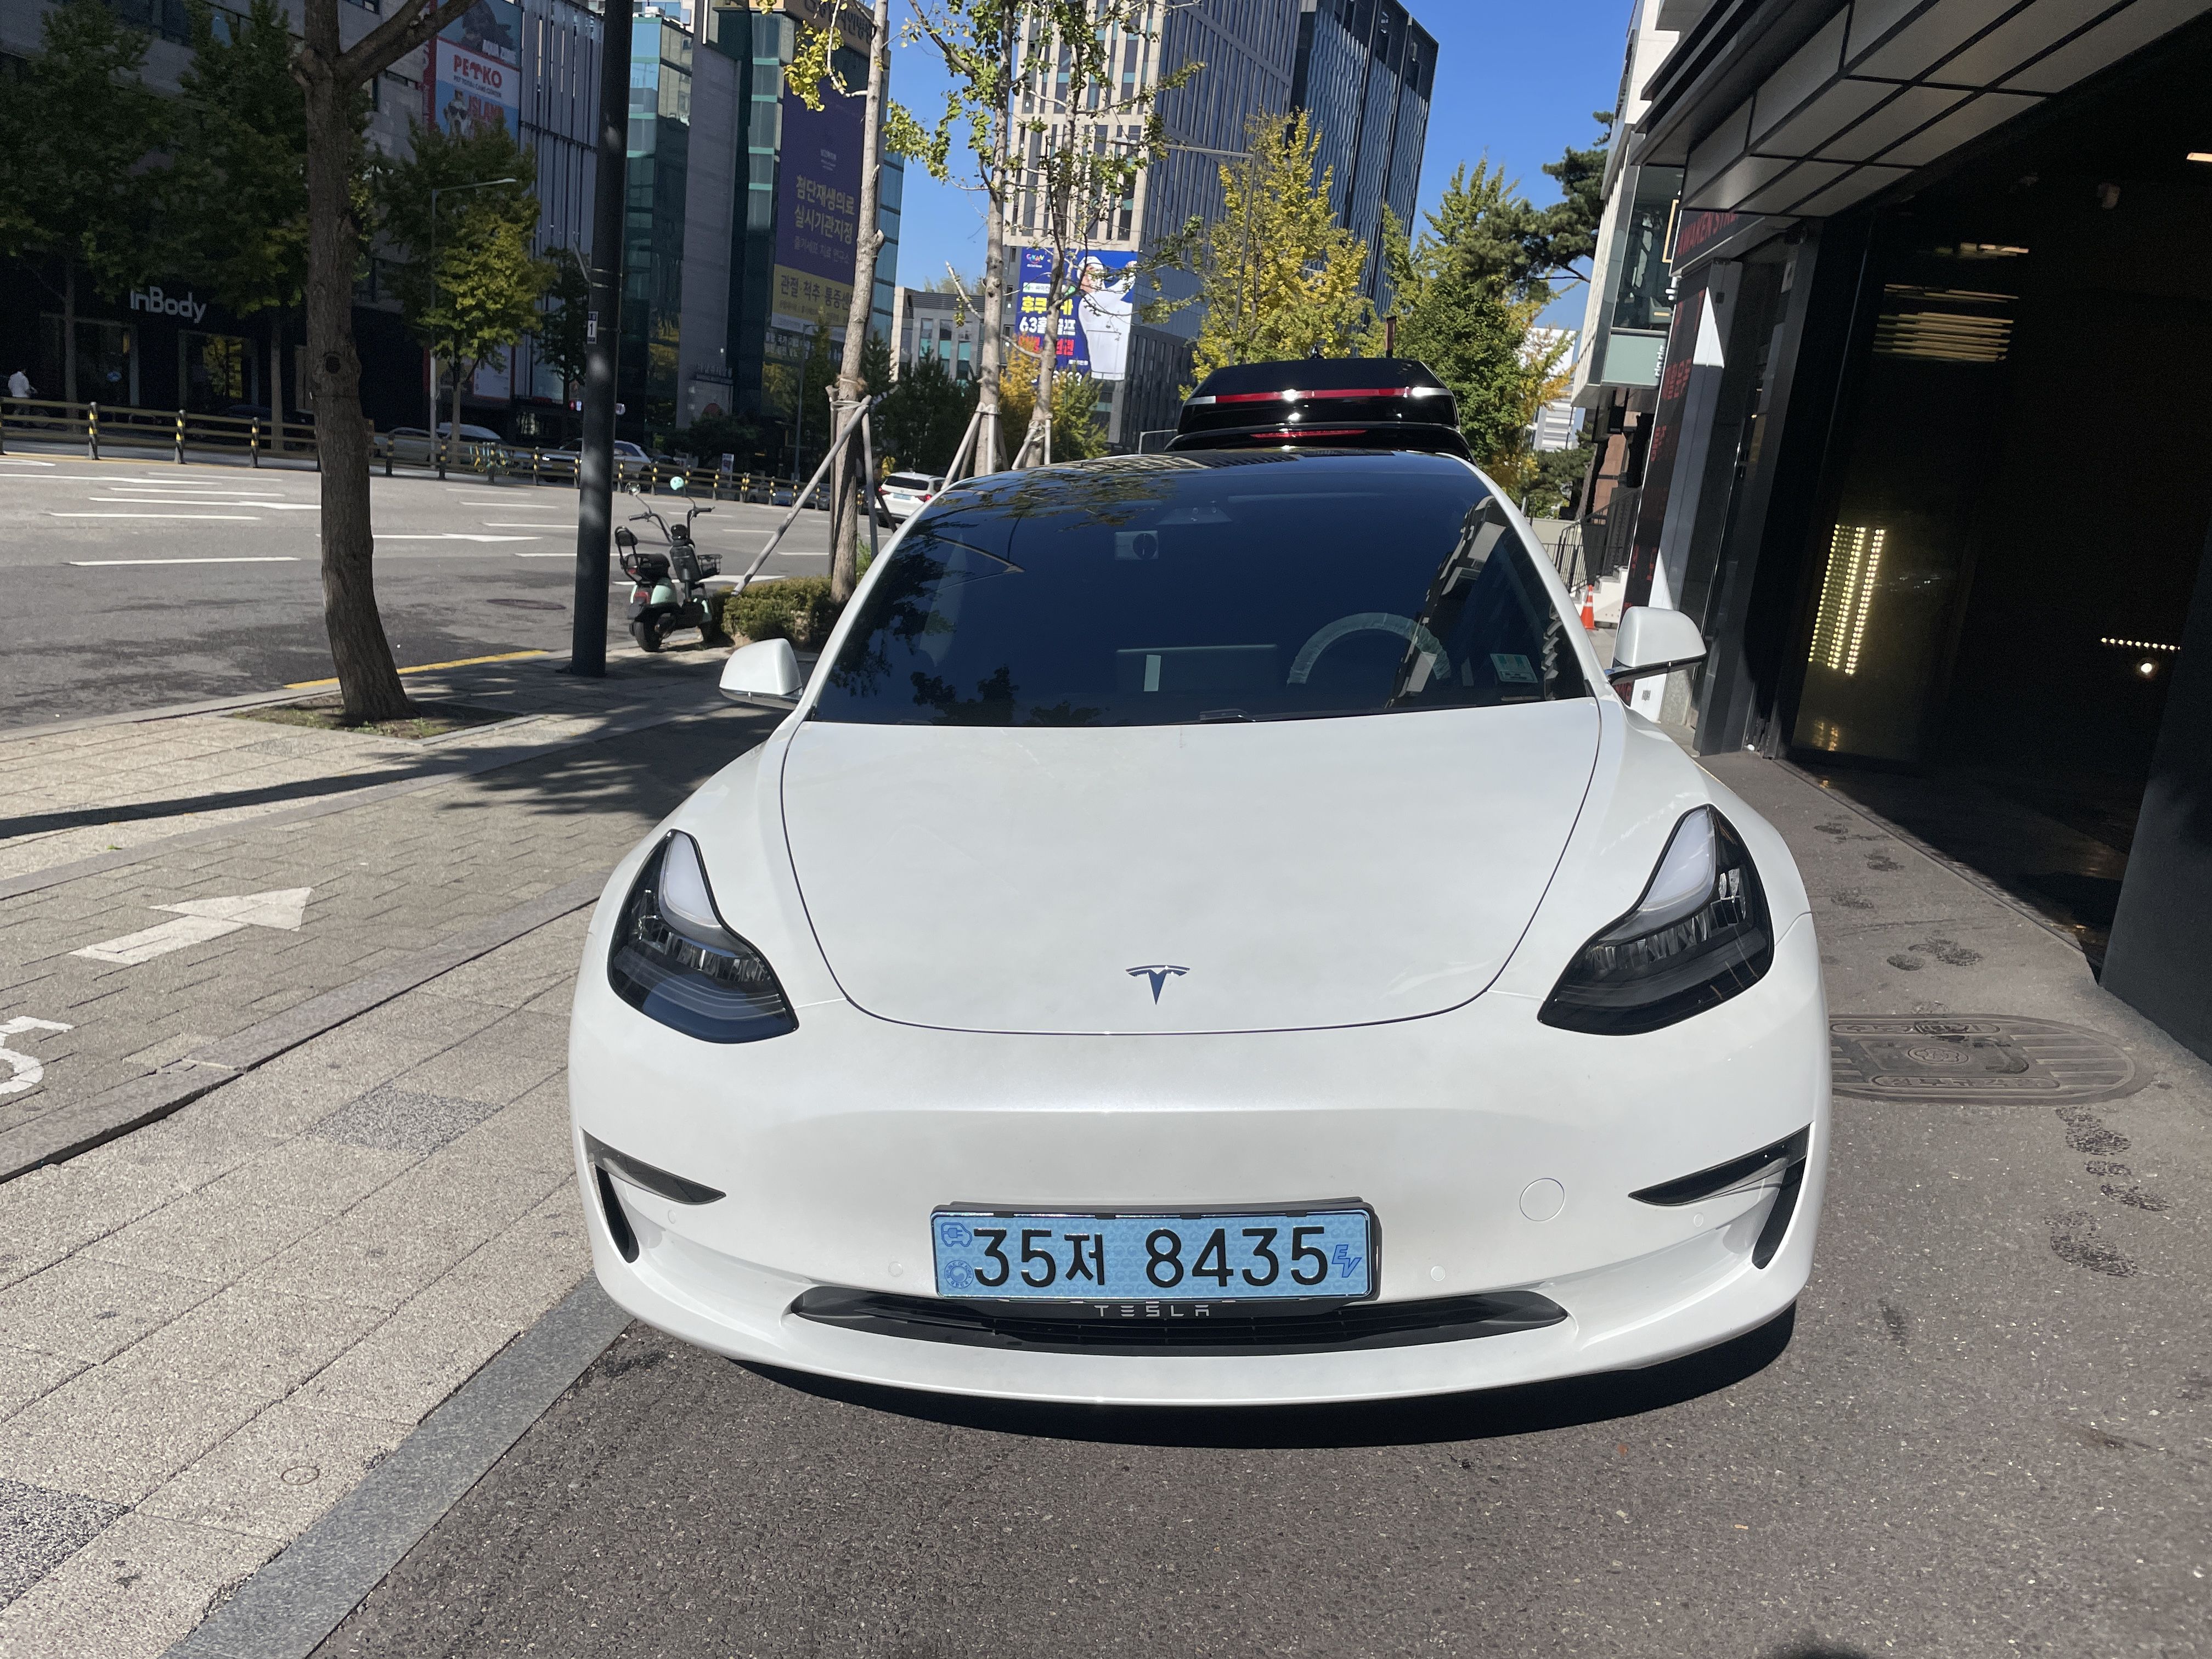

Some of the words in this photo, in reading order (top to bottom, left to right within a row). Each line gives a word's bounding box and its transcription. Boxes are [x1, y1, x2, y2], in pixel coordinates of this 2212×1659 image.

[796, 174, 855, 216] 첨단재생의료
[794, 204, 853, 245] 실시기관지정
[130, 286, 207, 324] InBody
[825, 286, 853, 311] 통증센
[1021, 295, 1074, 315] 후쿠카
[973, 1227, 1105, 1287] 35저
[1146, 1226, 1328, 1288] 8435
[1331, 1244, 1362, 1278] EV
[1094, 1305, 1210, 1317] TESLA
